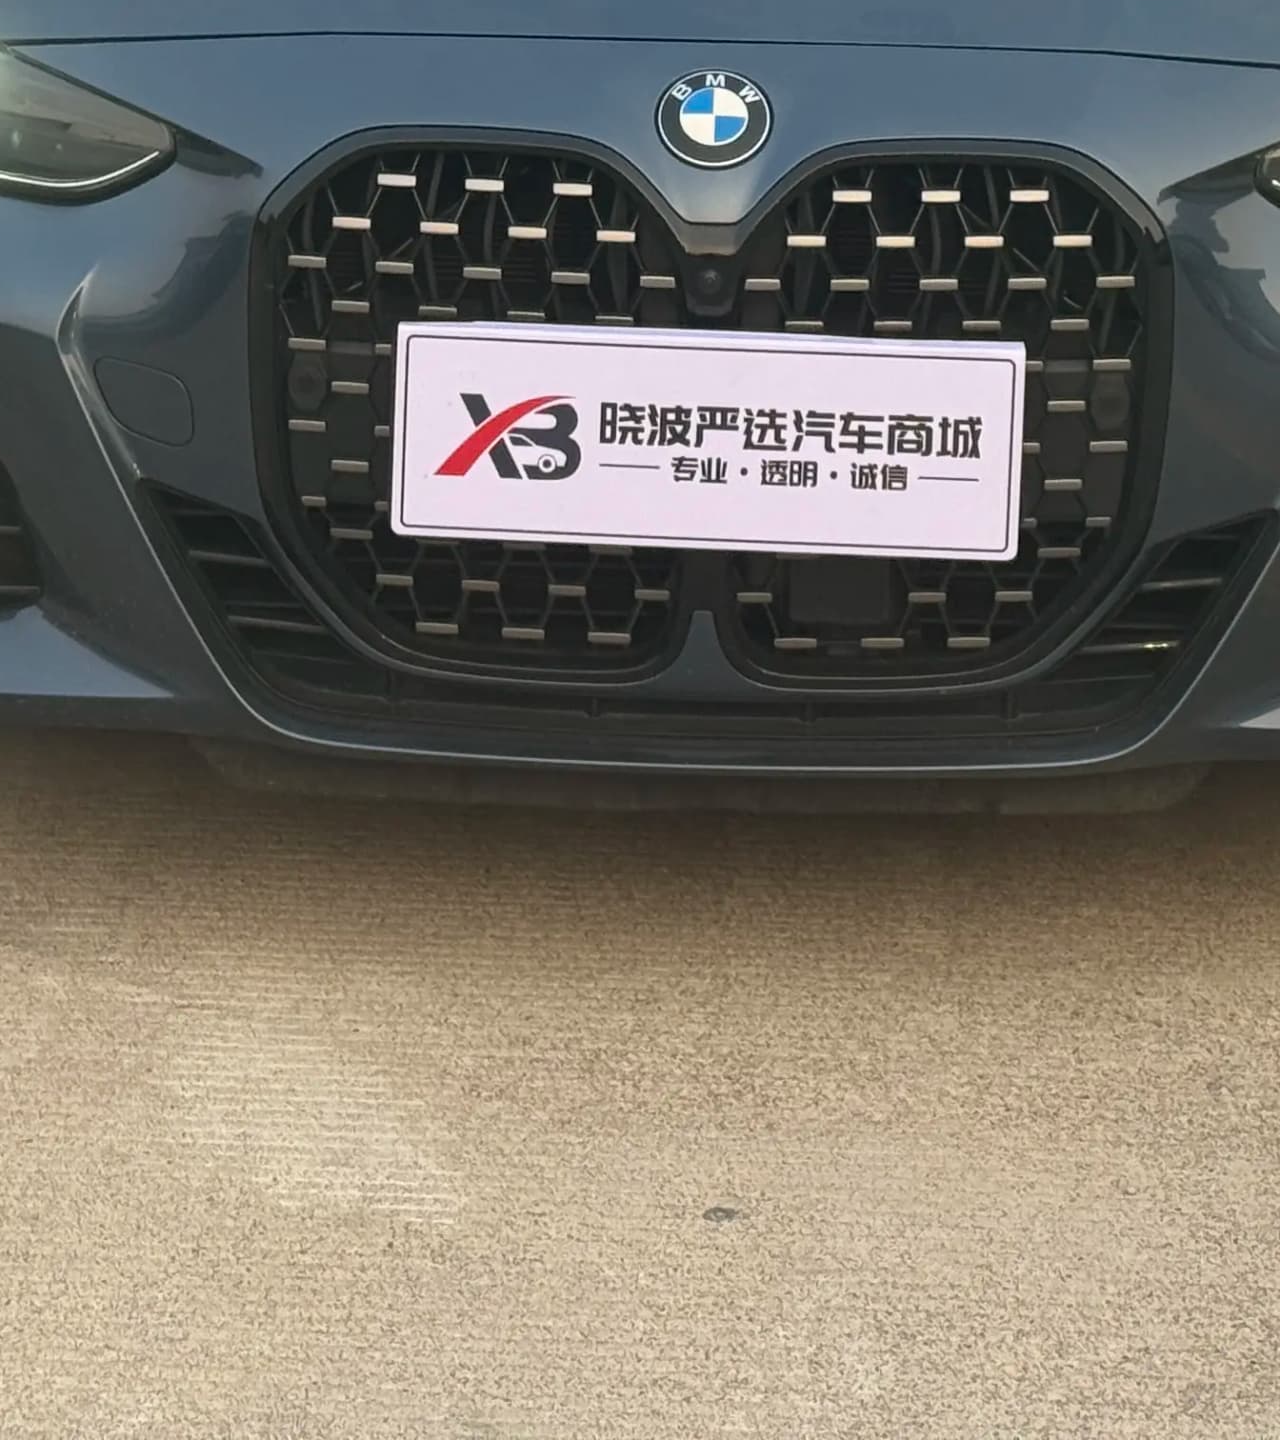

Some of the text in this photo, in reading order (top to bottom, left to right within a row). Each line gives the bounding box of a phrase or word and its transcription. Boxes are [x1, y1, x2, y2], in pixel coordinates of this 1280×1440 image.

[671, 73, 761, 104] BMW
[599, 401, 983, 459] 晓波严选汽车商城
